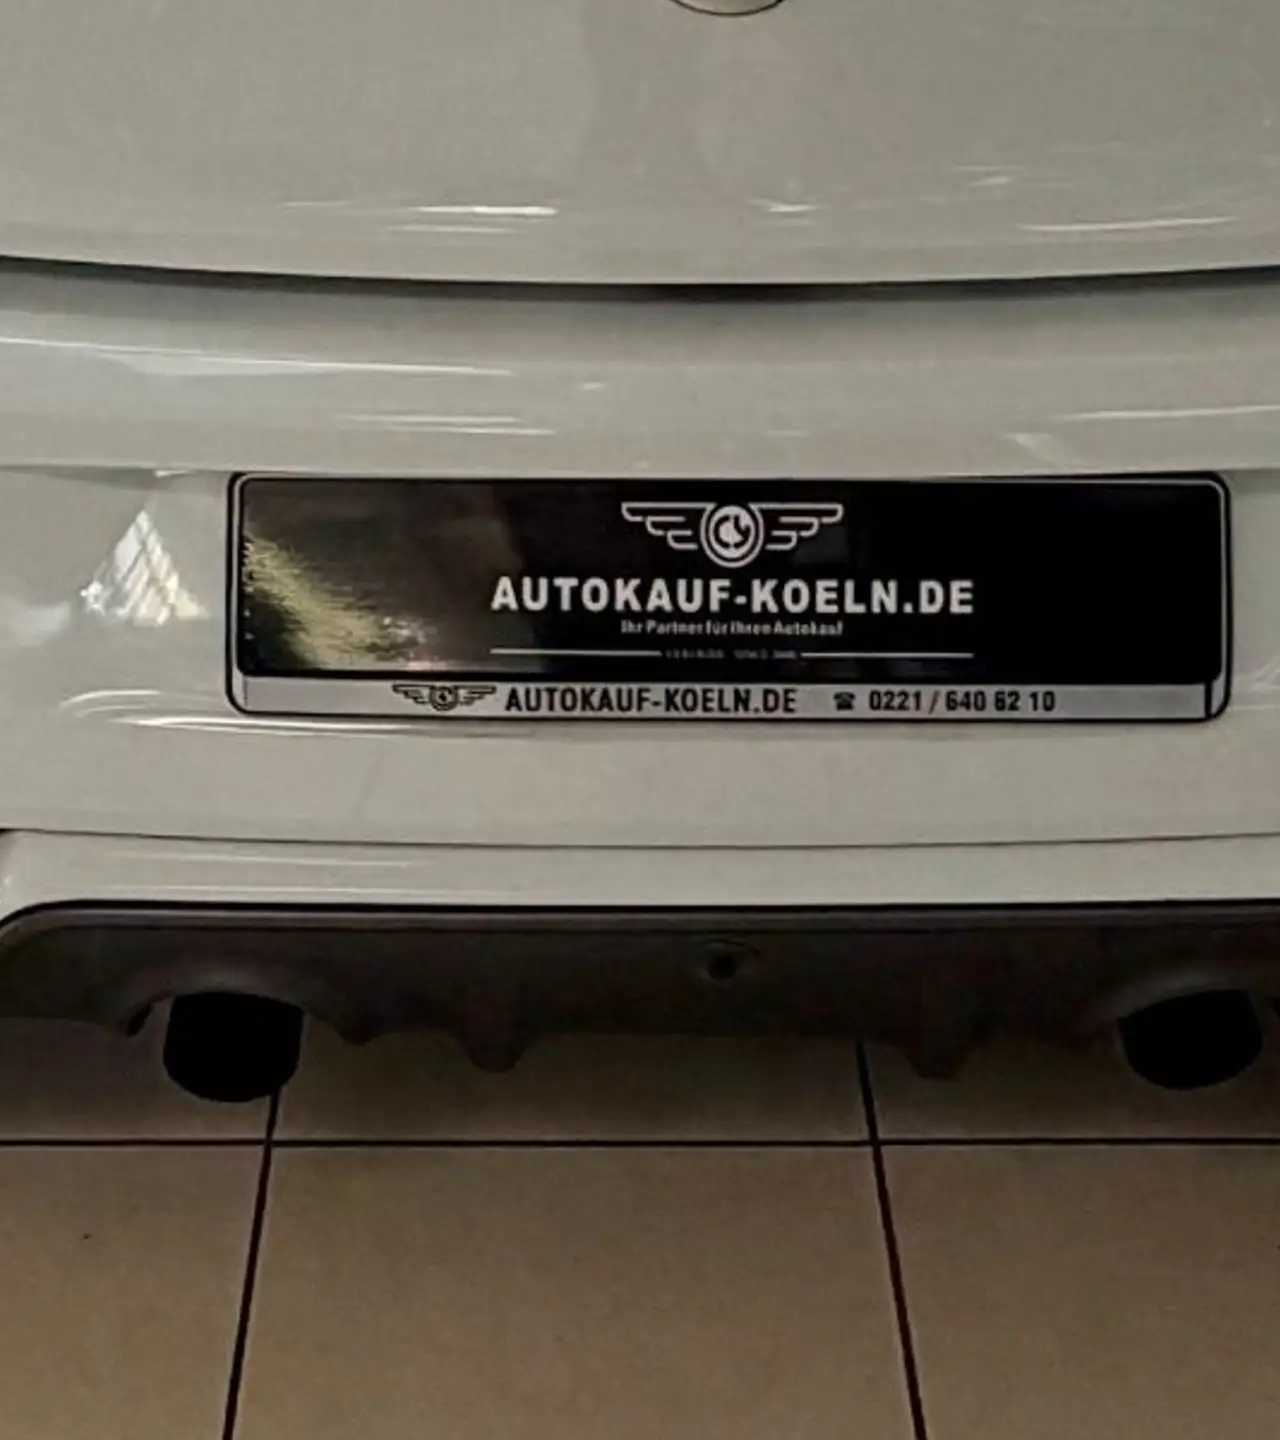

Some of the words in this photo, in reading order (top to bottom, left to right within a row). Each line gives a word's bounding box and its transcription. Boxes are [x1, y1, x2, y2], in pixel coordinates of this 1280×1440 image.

[489, 575, 974, 613] AUTOKAUF-KOELN.DE
[621, 618, 644, 634] Ihr
[646, 619, 704, 635] Partner
[705, 619, 727, 635] für
[730, 619, 772, 636] Ihren
[774, 620, 843, 636] Autokauf
[505, 686, 797, 713] AUTOKAUF-KOELN.DE
[868, 690, 921, 712] 0221
[944, 690, 987, 712] 640
[993, 690, 1021, 712] 62
[1028, 690, 1056, 711] 10
